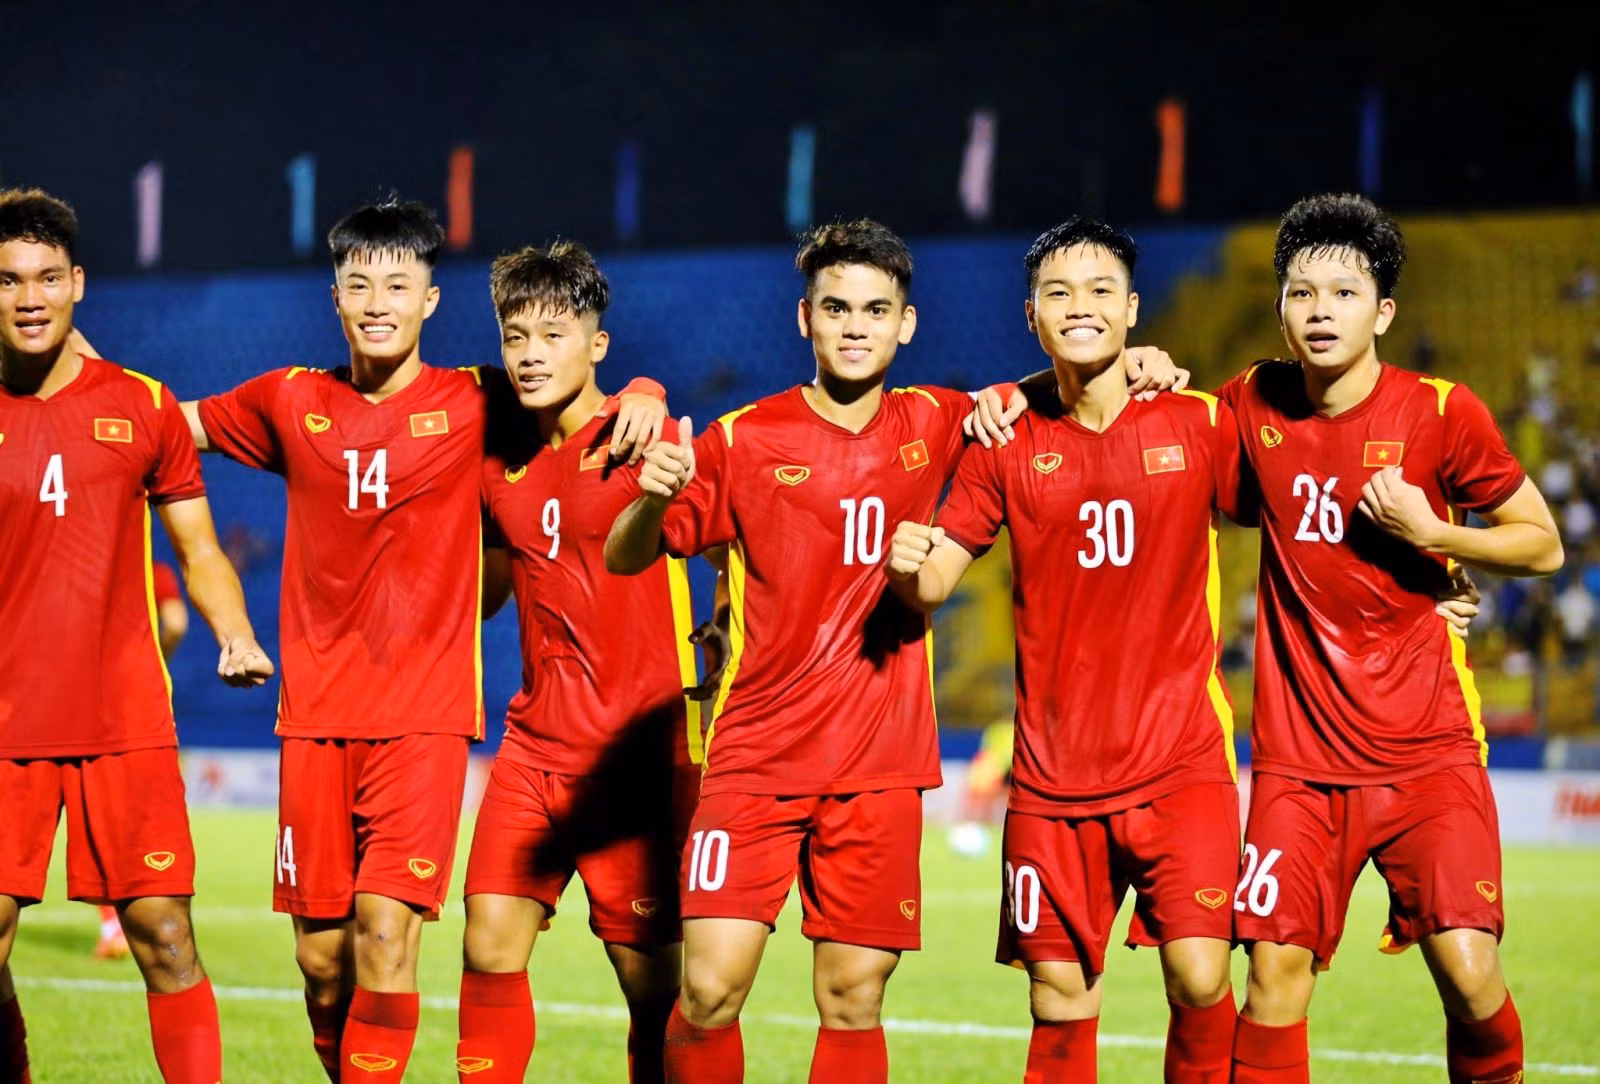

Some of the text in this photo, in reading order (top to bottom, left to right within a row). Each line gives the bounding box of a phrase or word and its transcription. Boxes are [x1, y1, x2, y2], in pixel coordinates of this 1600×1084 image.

[39, 453, 69, 517] 4
[343, 448, 390, 510] 14
[1292, 473, 1344, 544] 26
[541, 497, 561, 560] 9
[839, 496, 885, 567] 10
[1077, 499, 1135, 569] 30
[688, 829, 730, 892] 10
[1233, 843, 1283, 917] 26
